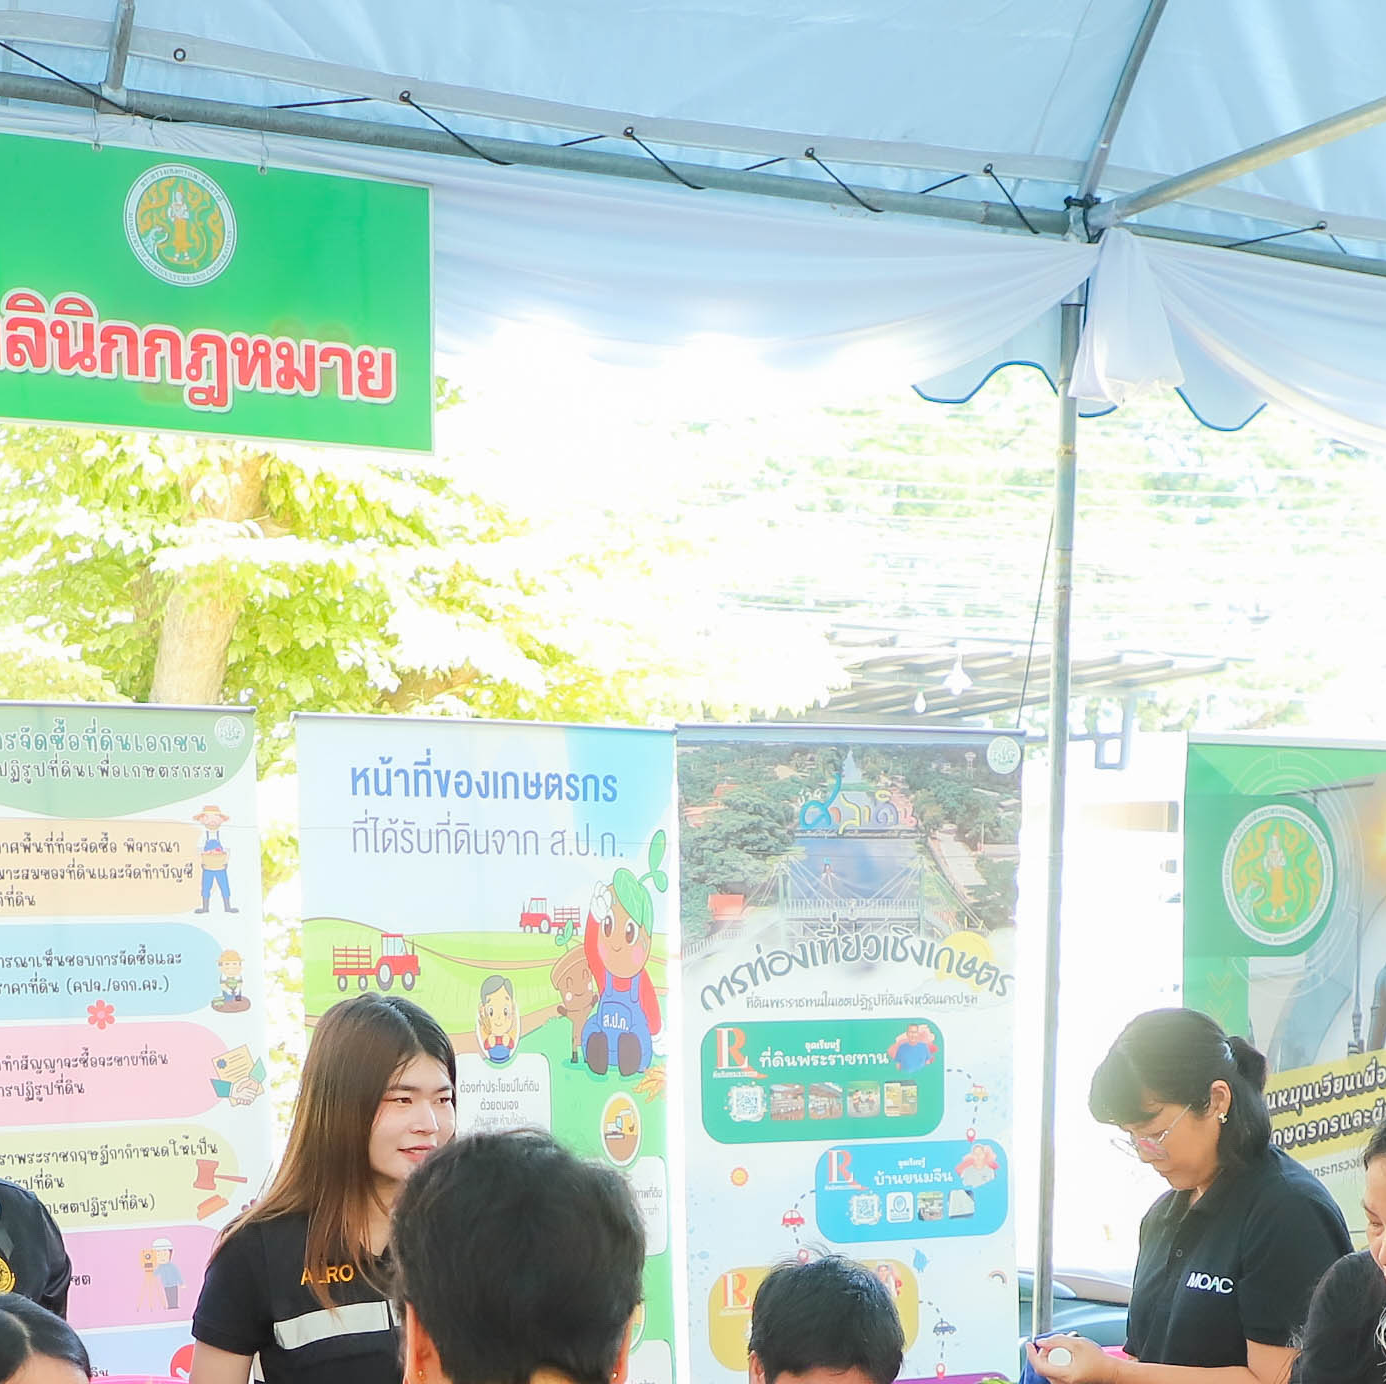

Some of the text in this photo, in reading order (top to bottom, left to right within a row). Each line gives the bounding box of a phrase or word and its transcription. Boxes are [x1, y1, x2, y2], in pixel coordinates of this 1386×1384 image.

[350, 749, 618, 802] หน้าที่ของเกษตรกร
[352, 810, 624, 858] ที่ได้รับที่ดินจาก ส.ป.ก.
[124, 836, 181, 855] พิจารณา
[602, 1012, 629, 1032] ส.ป.ก.
[759, 1046, 889, 1068] ที่ดินพระราชทาน
[1185, 1271, 1234, 1294] MOAC
